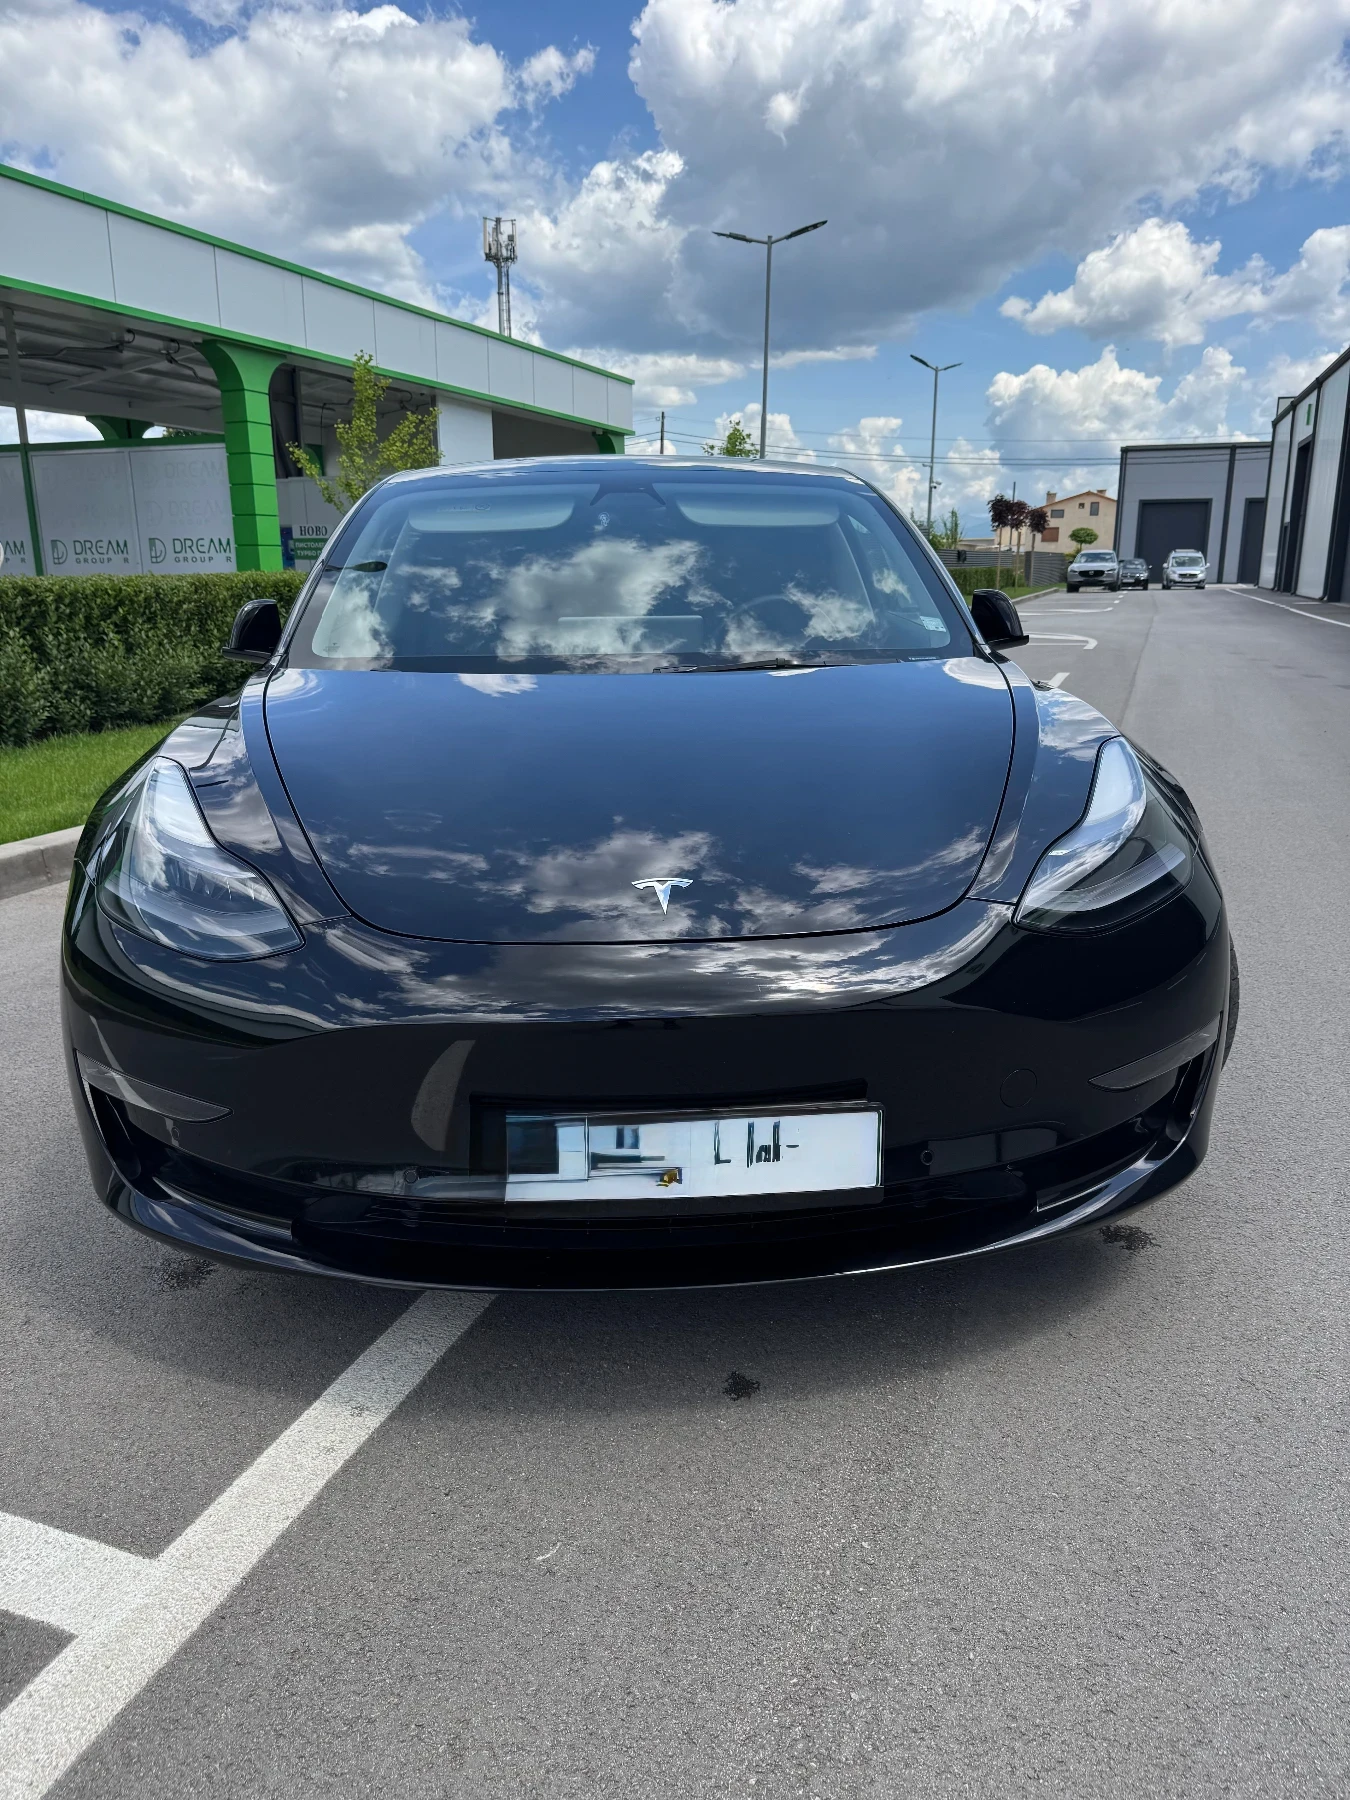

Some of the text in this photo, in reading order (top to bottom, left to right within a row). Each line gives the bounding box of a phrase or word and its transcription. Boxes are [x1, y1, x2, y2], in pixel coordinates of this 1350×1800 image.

[299, 525, 328, 537] НОВО
[73, 539, 129, 556] DREAM
[172, 537, 232, 554] DREAM
[174, 556, 233, 564] GROUP R
